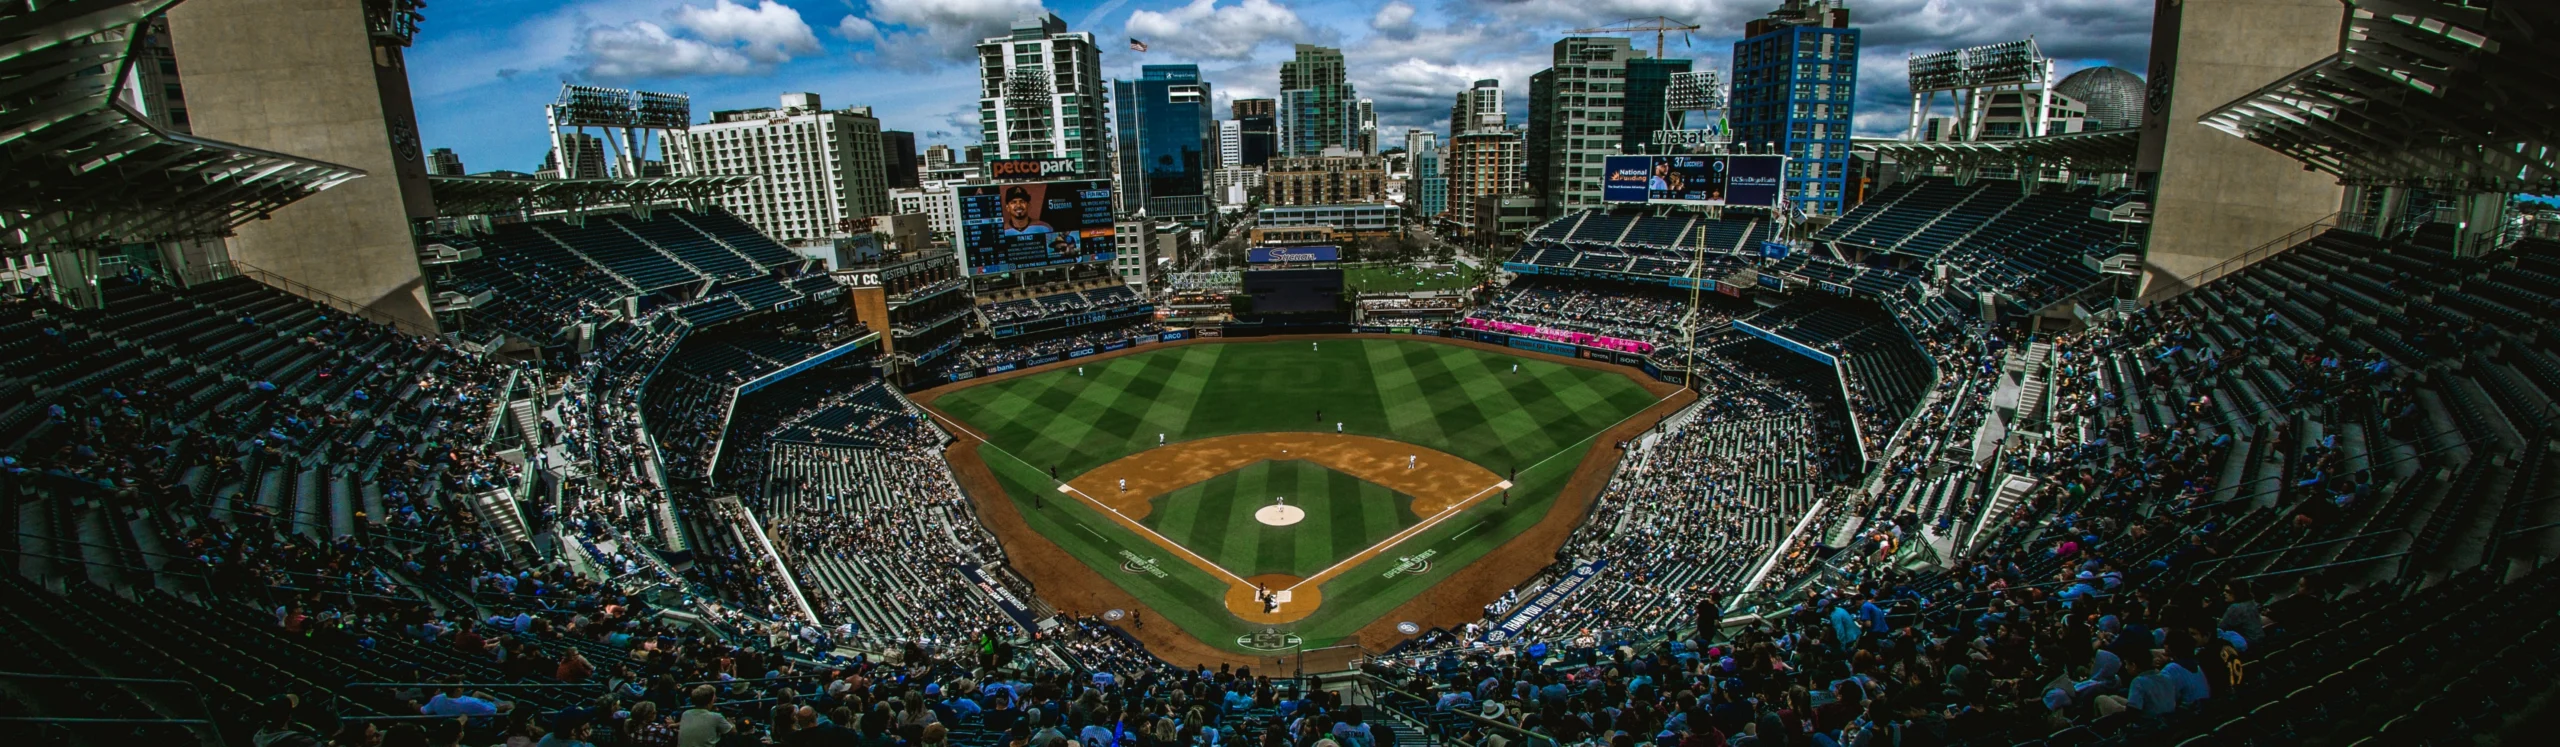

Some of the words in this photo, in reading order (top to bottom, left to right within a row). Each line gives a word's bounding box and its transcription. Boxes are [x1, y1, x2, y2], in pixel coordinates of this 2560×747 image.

[1655, 130, 1706, 144] Viasat
[1674, 157, 1684, 167] 37
[1048, 199, 1054, 210] 5
[850, 217, 879, 230] TOYOTA
[1269, 247, 1317, 266] Sycuan
[881, 266, 908, 281] WESTERN
[909, 263, 927, 273] METAL
[927, 257, 945, 269] SUPPLY
[946, 255, 955, 264] CO.
[863, 273, 882, 285] CO.
[1164, 333, 1181, 341] ARCO
[1070, 348, 1094, 358] GEICO
[1663, 374, 1682, 384] NECA
[1119, 549, 1145, 566] OPENING
[1143, 563, 1168, 578] SERIES
[1382, 560, 1416, 578] OPENING
[1410, 548, 1437, 563] SERIES
[975, 568, 998, 585] WELCOME
[1502, 616, 1532, 632] THANK
[1535, 592, 1560, 608] FRIAR
